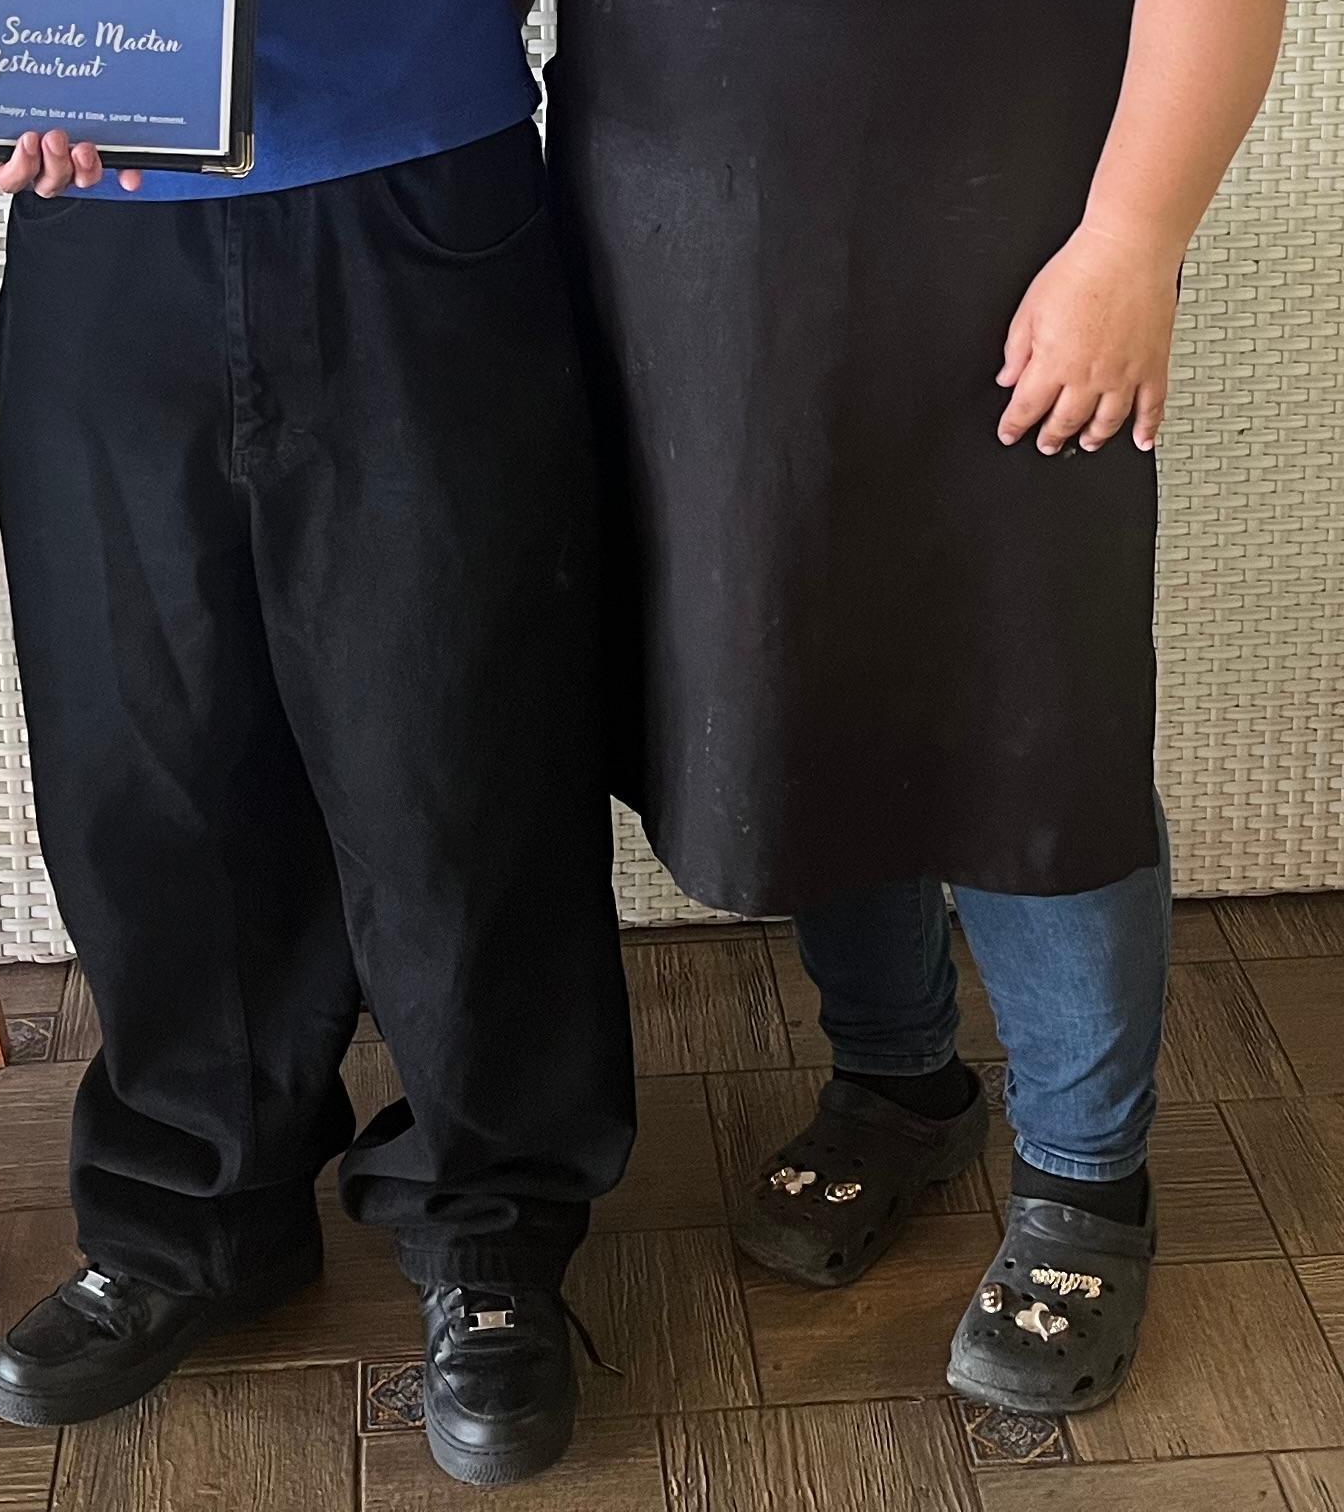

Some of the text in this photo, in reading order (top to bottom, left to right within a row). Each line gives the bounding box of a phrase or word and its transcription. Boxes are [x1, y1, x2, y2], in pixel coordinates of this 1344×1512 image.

[2, 16, 86, 48] Seaside
[95, 22, 183, 53] Mactan
[30, 107, 47, 117] One
[49, 109, 65, 118] bite
[133, 113, 148, 123] the
